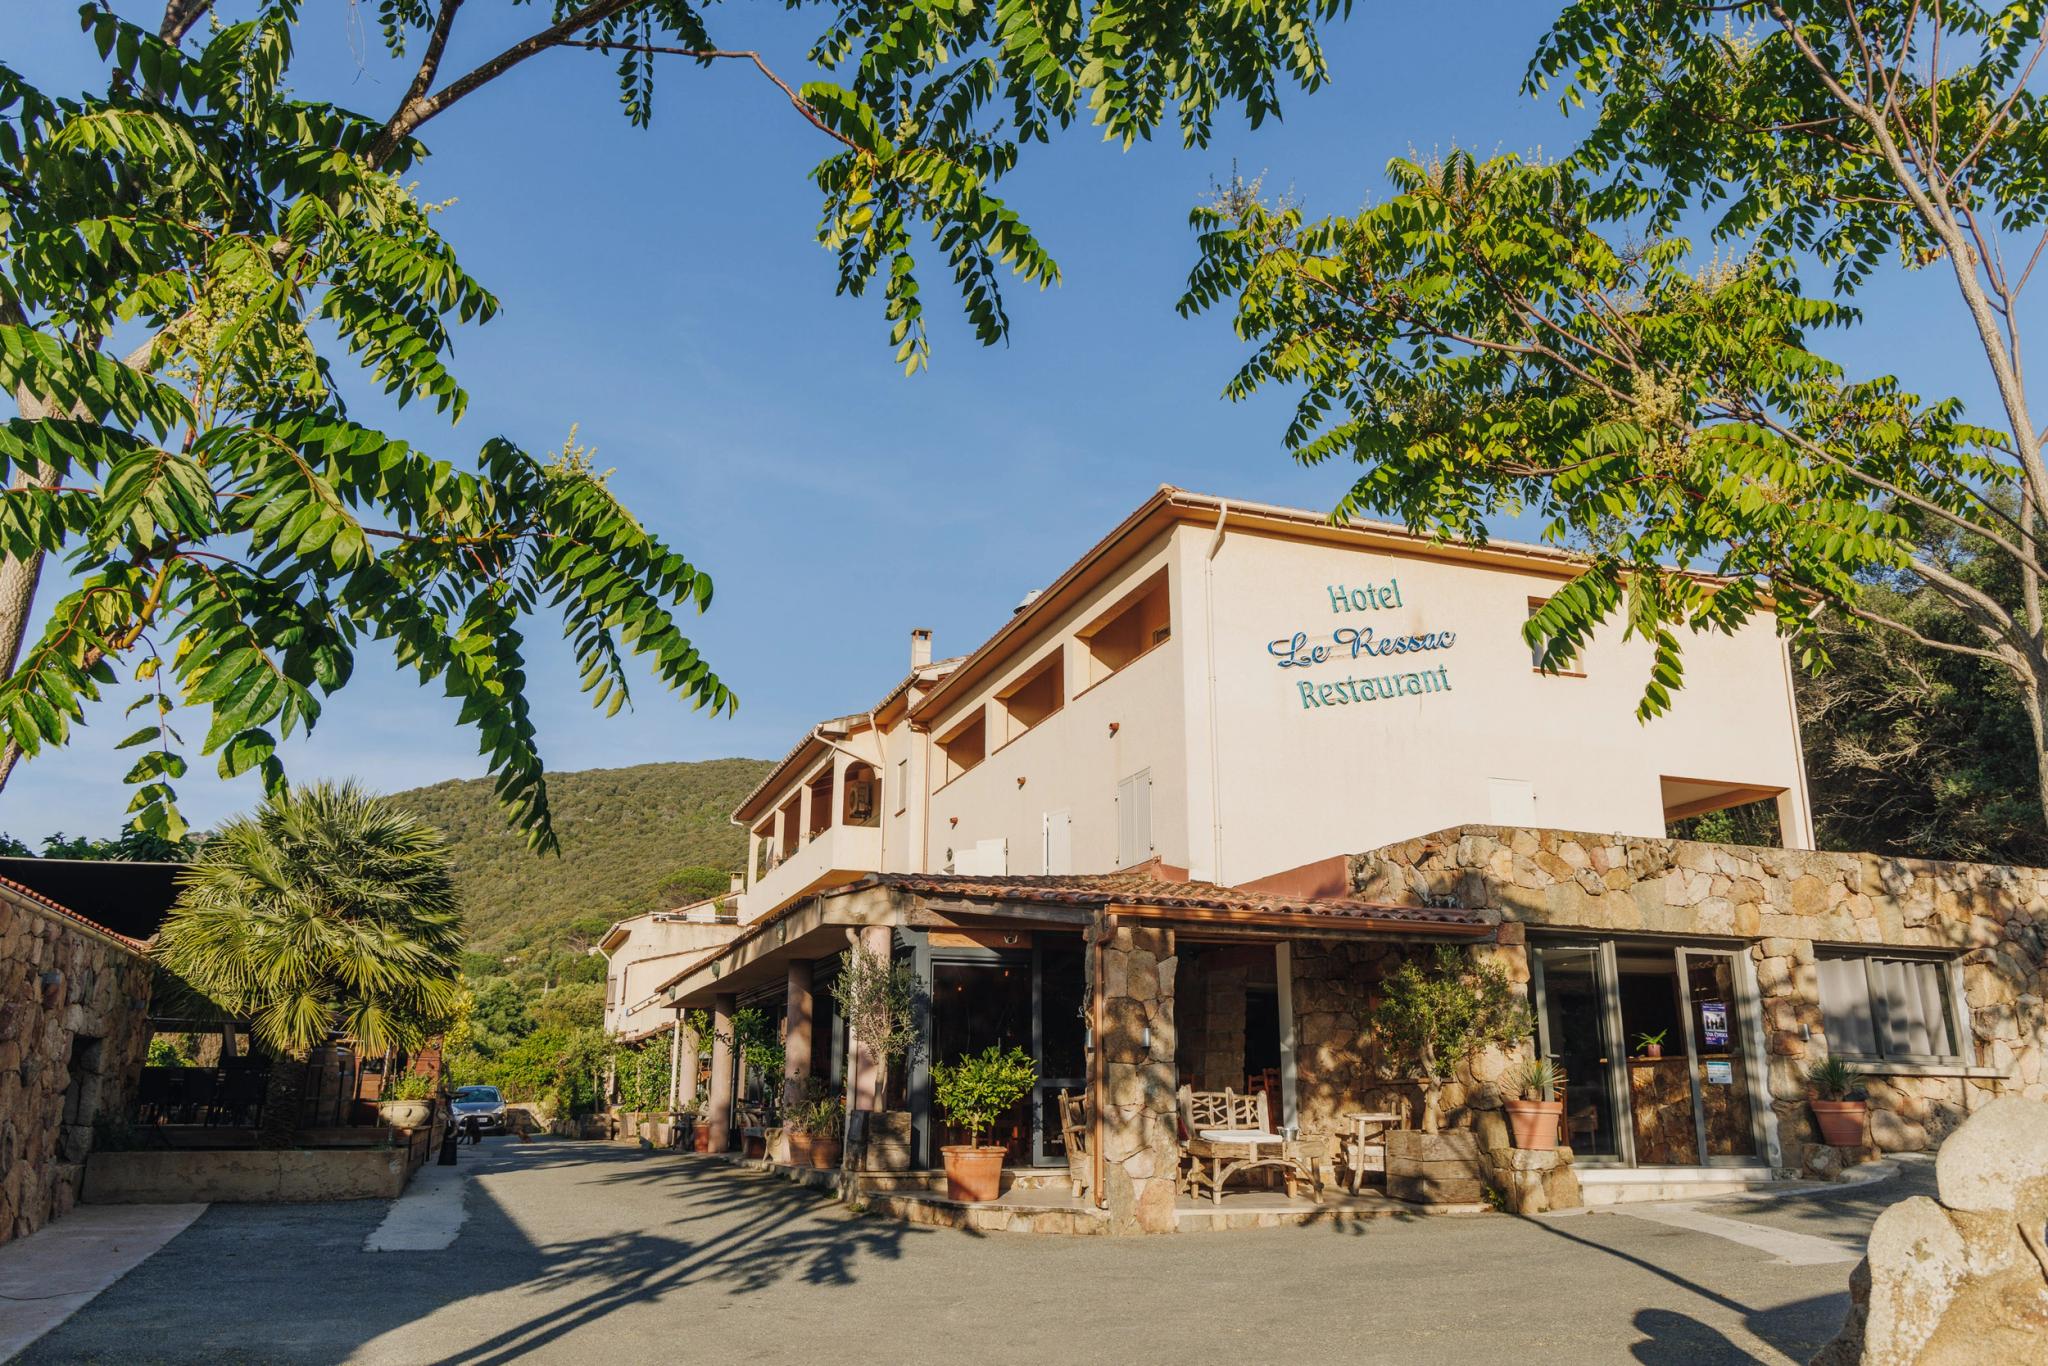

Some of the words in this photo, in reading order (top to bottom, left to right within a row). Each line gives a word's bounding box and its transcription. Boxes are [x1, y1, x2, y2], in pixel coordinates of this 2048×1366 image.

[1327, 578, 1403, 613] Hotel
[1267, 631, 1331, 668] Le
[1333, 627, 1457, 659] Ressac
[1296, 664, 1453, 709] Restaurant
